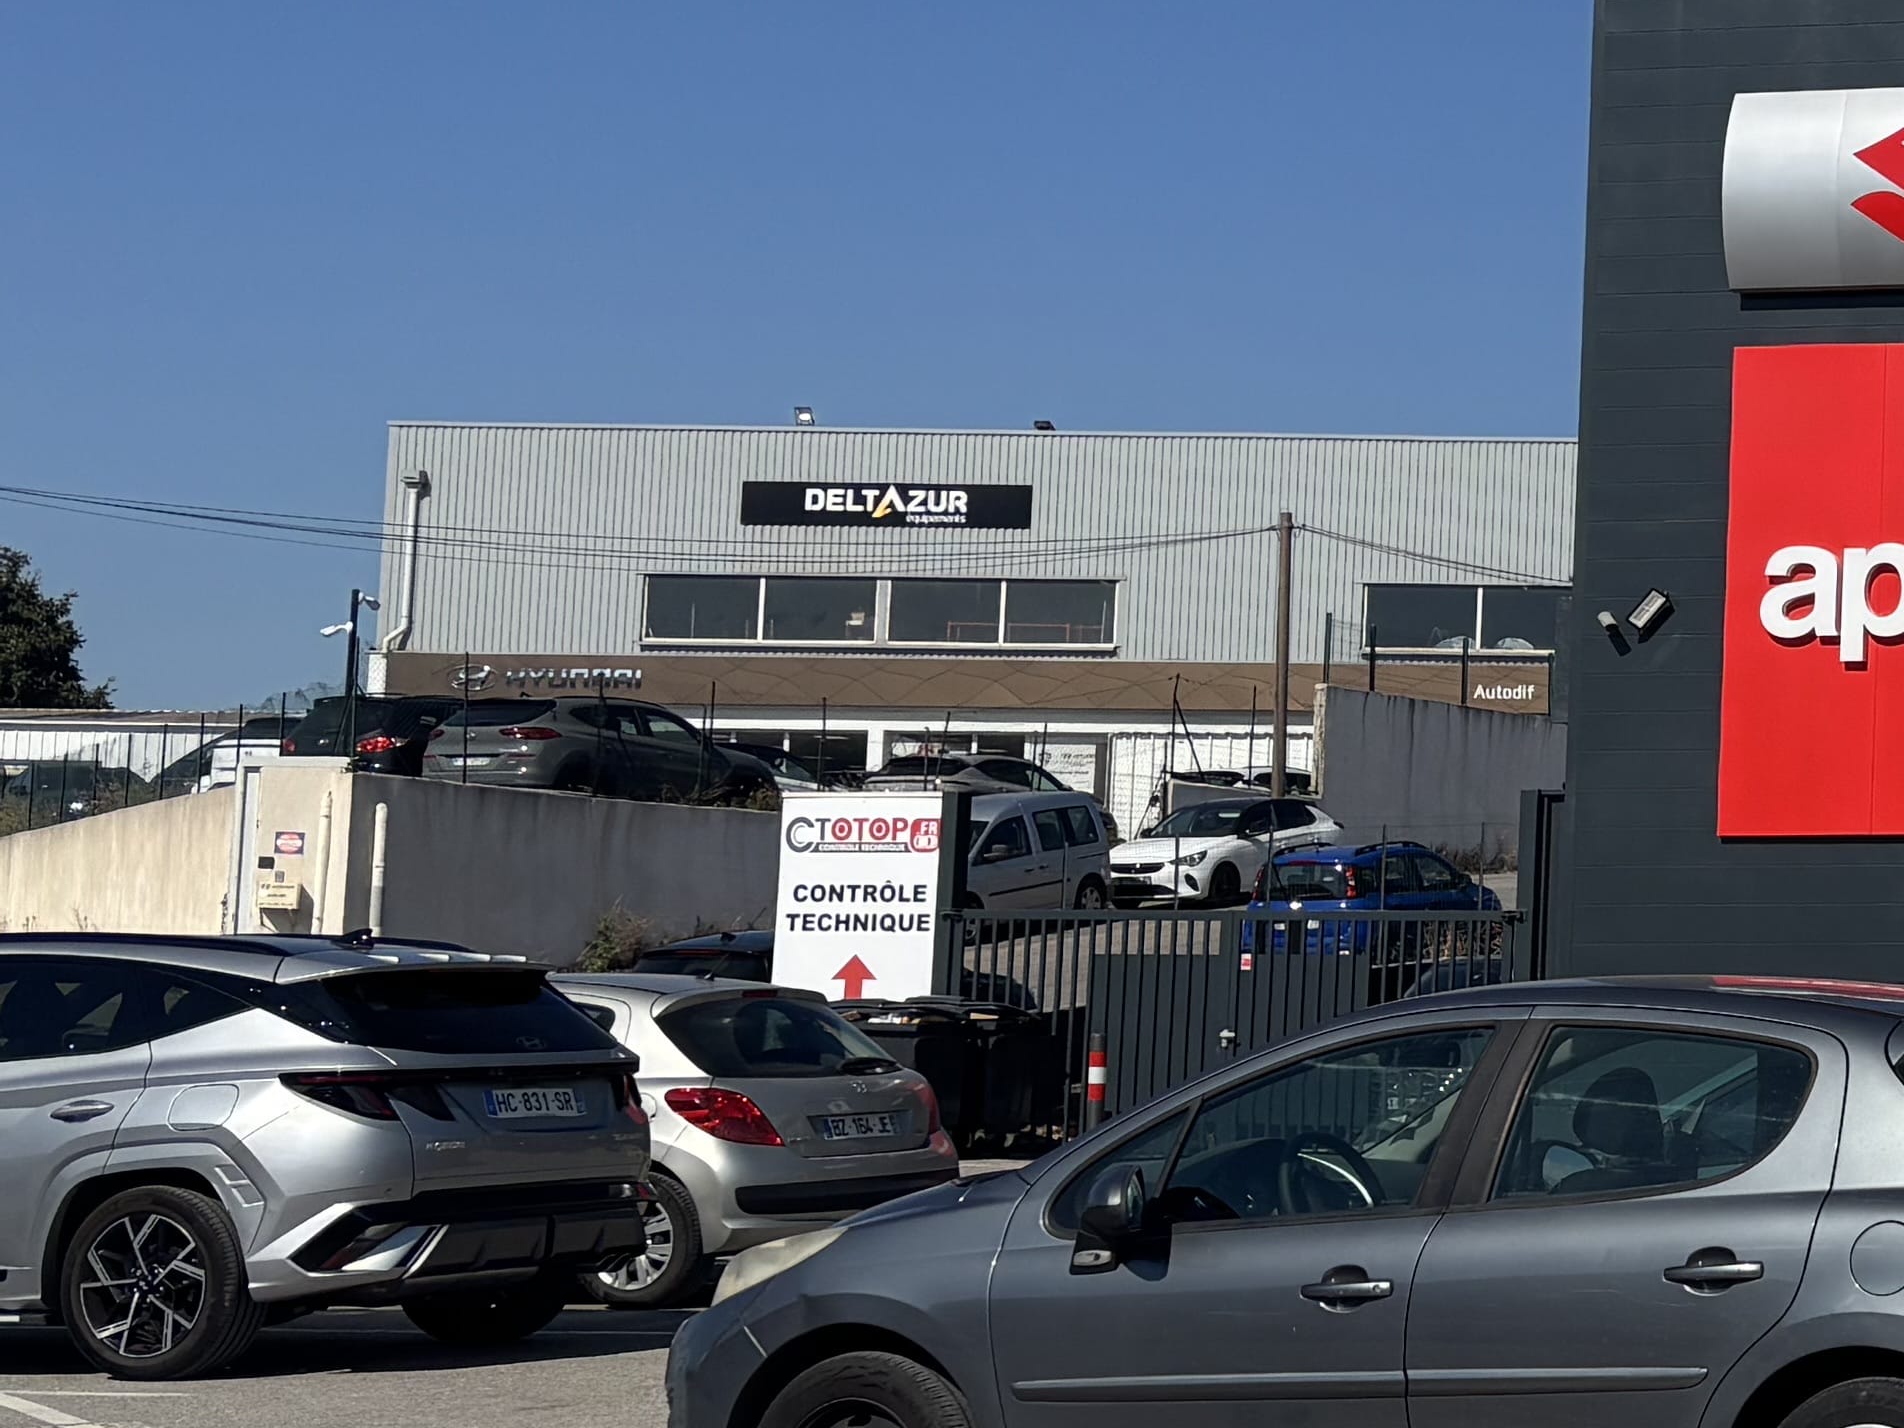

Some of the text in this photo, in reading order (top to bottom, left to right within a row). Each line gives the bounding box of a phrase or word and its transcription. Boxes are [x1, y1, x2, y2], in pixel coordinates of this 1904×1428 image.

[804, 483, 968, 518] DELTAZUR
[1473, 683, 1535, 701] Autodif
[793, 879, 928, 903] CONTRÔLE
[785, 913, 931, 933] TECHNIQUE
